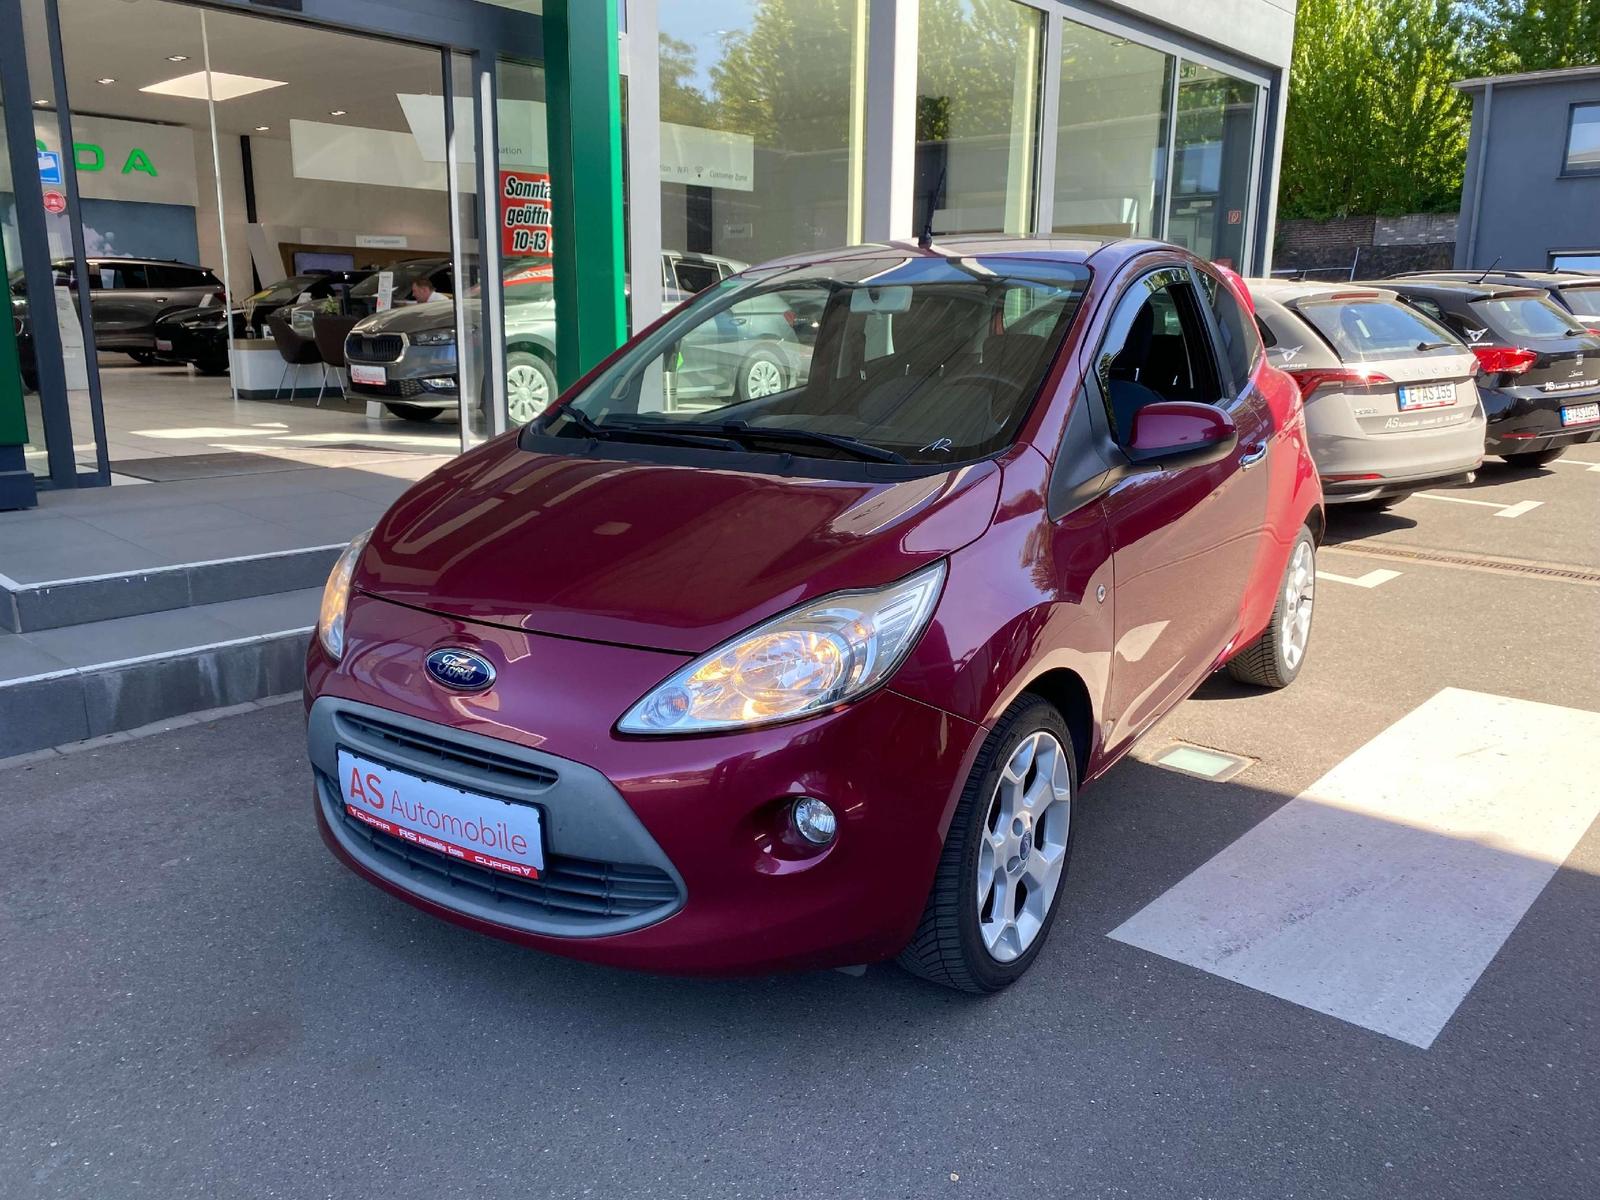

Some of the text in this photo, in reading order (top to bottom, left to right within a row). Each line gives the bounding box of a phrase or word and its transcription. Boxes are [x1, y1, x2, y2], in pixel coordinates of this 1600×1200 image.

[513, 231, 547, 250] 10-13
[1409, 388, 1417, 403] E
[1422, 386, 1435, 401] AS
[1384, 417, 1400, 429] AS
[437, 654, 477, 681] Ford
[350, 767, 527, 855] AS Automobile
[399, 829, 417, 842] AS
